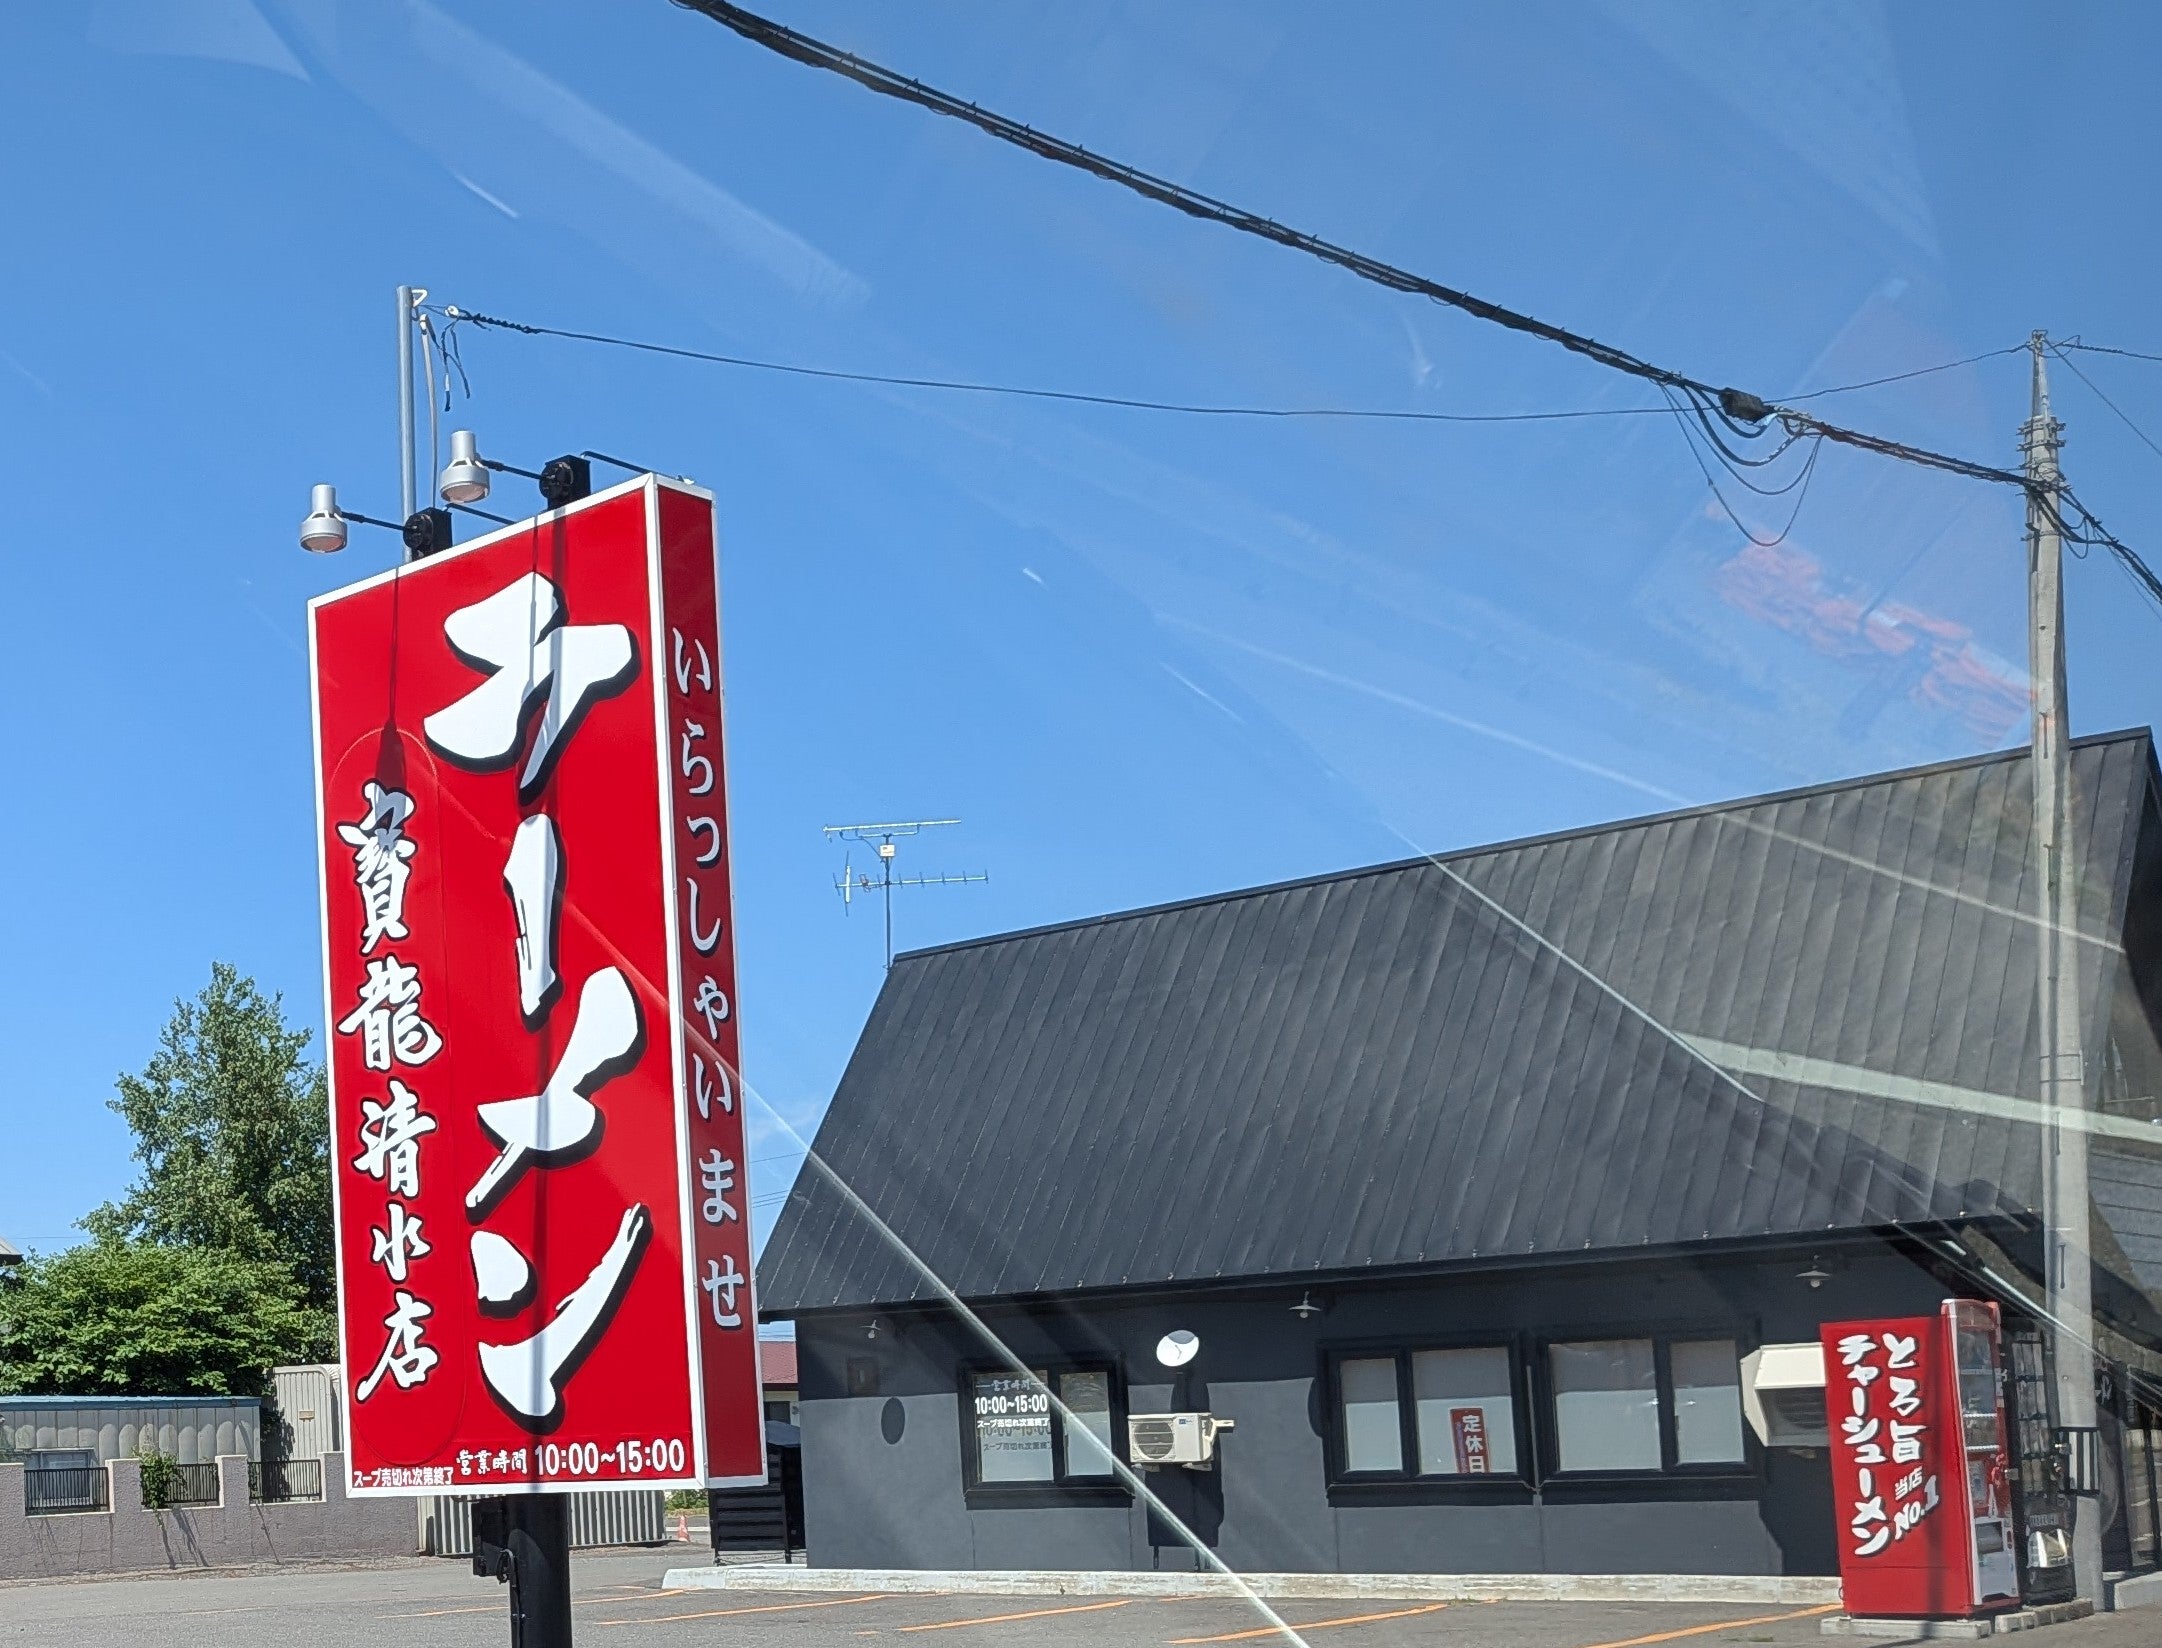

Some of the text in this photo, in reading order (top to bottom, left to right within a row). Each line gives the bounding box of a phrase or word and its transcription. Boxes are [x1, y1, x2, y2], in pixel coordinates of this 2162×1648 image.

[1882, 1333, 1927, 1464] とろ旨
[456, 1448, 528, 1474] 営業時間
[1462, 1414, 1486, 1473] 定休日
[1837, 1335, 1890, 1555] チャーシューメン
[353, 1467, 454, 1487] スープ売切れ次第終了
[1895, 1466, 1923, 1500] 当店
